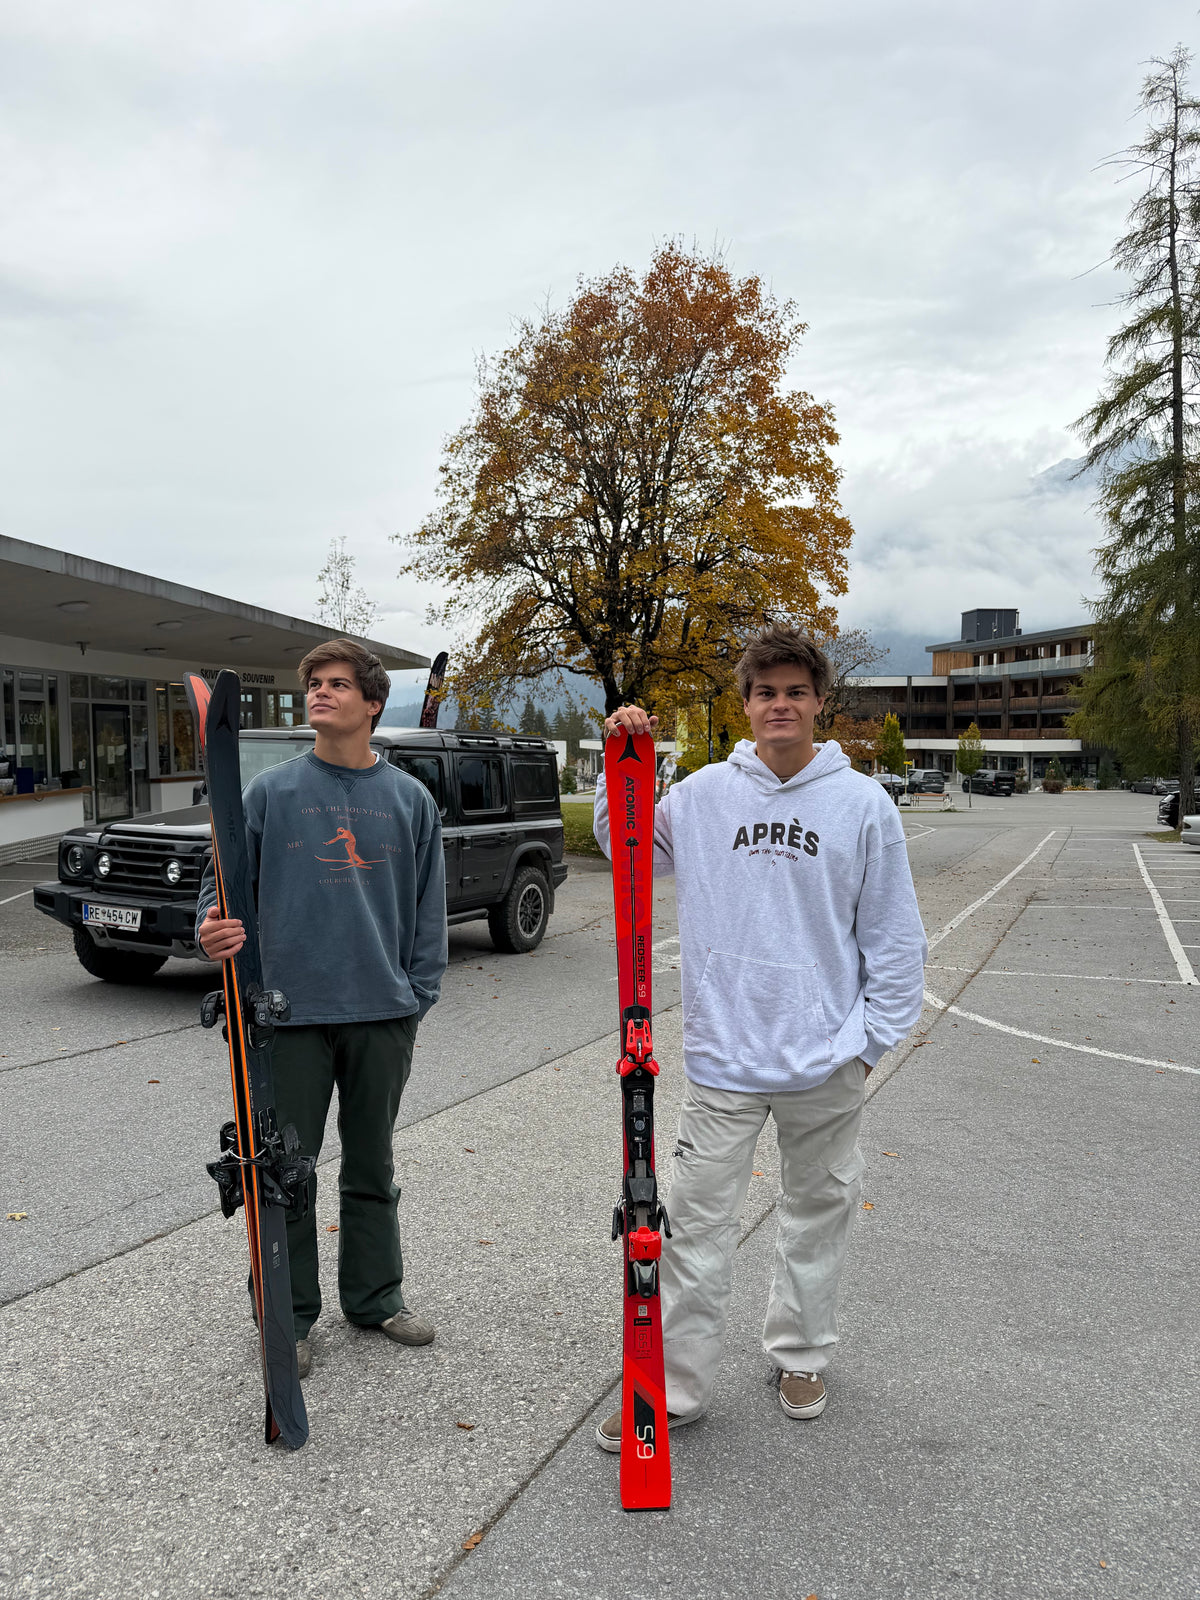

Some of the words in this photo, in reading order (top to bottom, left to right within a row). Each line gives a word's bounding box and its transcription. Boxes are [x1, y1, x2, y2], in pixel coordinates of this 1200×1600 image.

[242, 672, 275, 685] SOUVENIR
[301, 806, 321, 815] OWN
[625, 776, 636, 830] ATOMIC
[732, 817, 820, 857] APRÈS
[89, 906, 100, 920] RE
[106, 908, 123, 923] 454
[125, 911, 139, 925] CW
[637, 935, 646, 983] REDSTER
[638, 984, 647, 998] S9
[636, 1424, 655, 1459] S9
